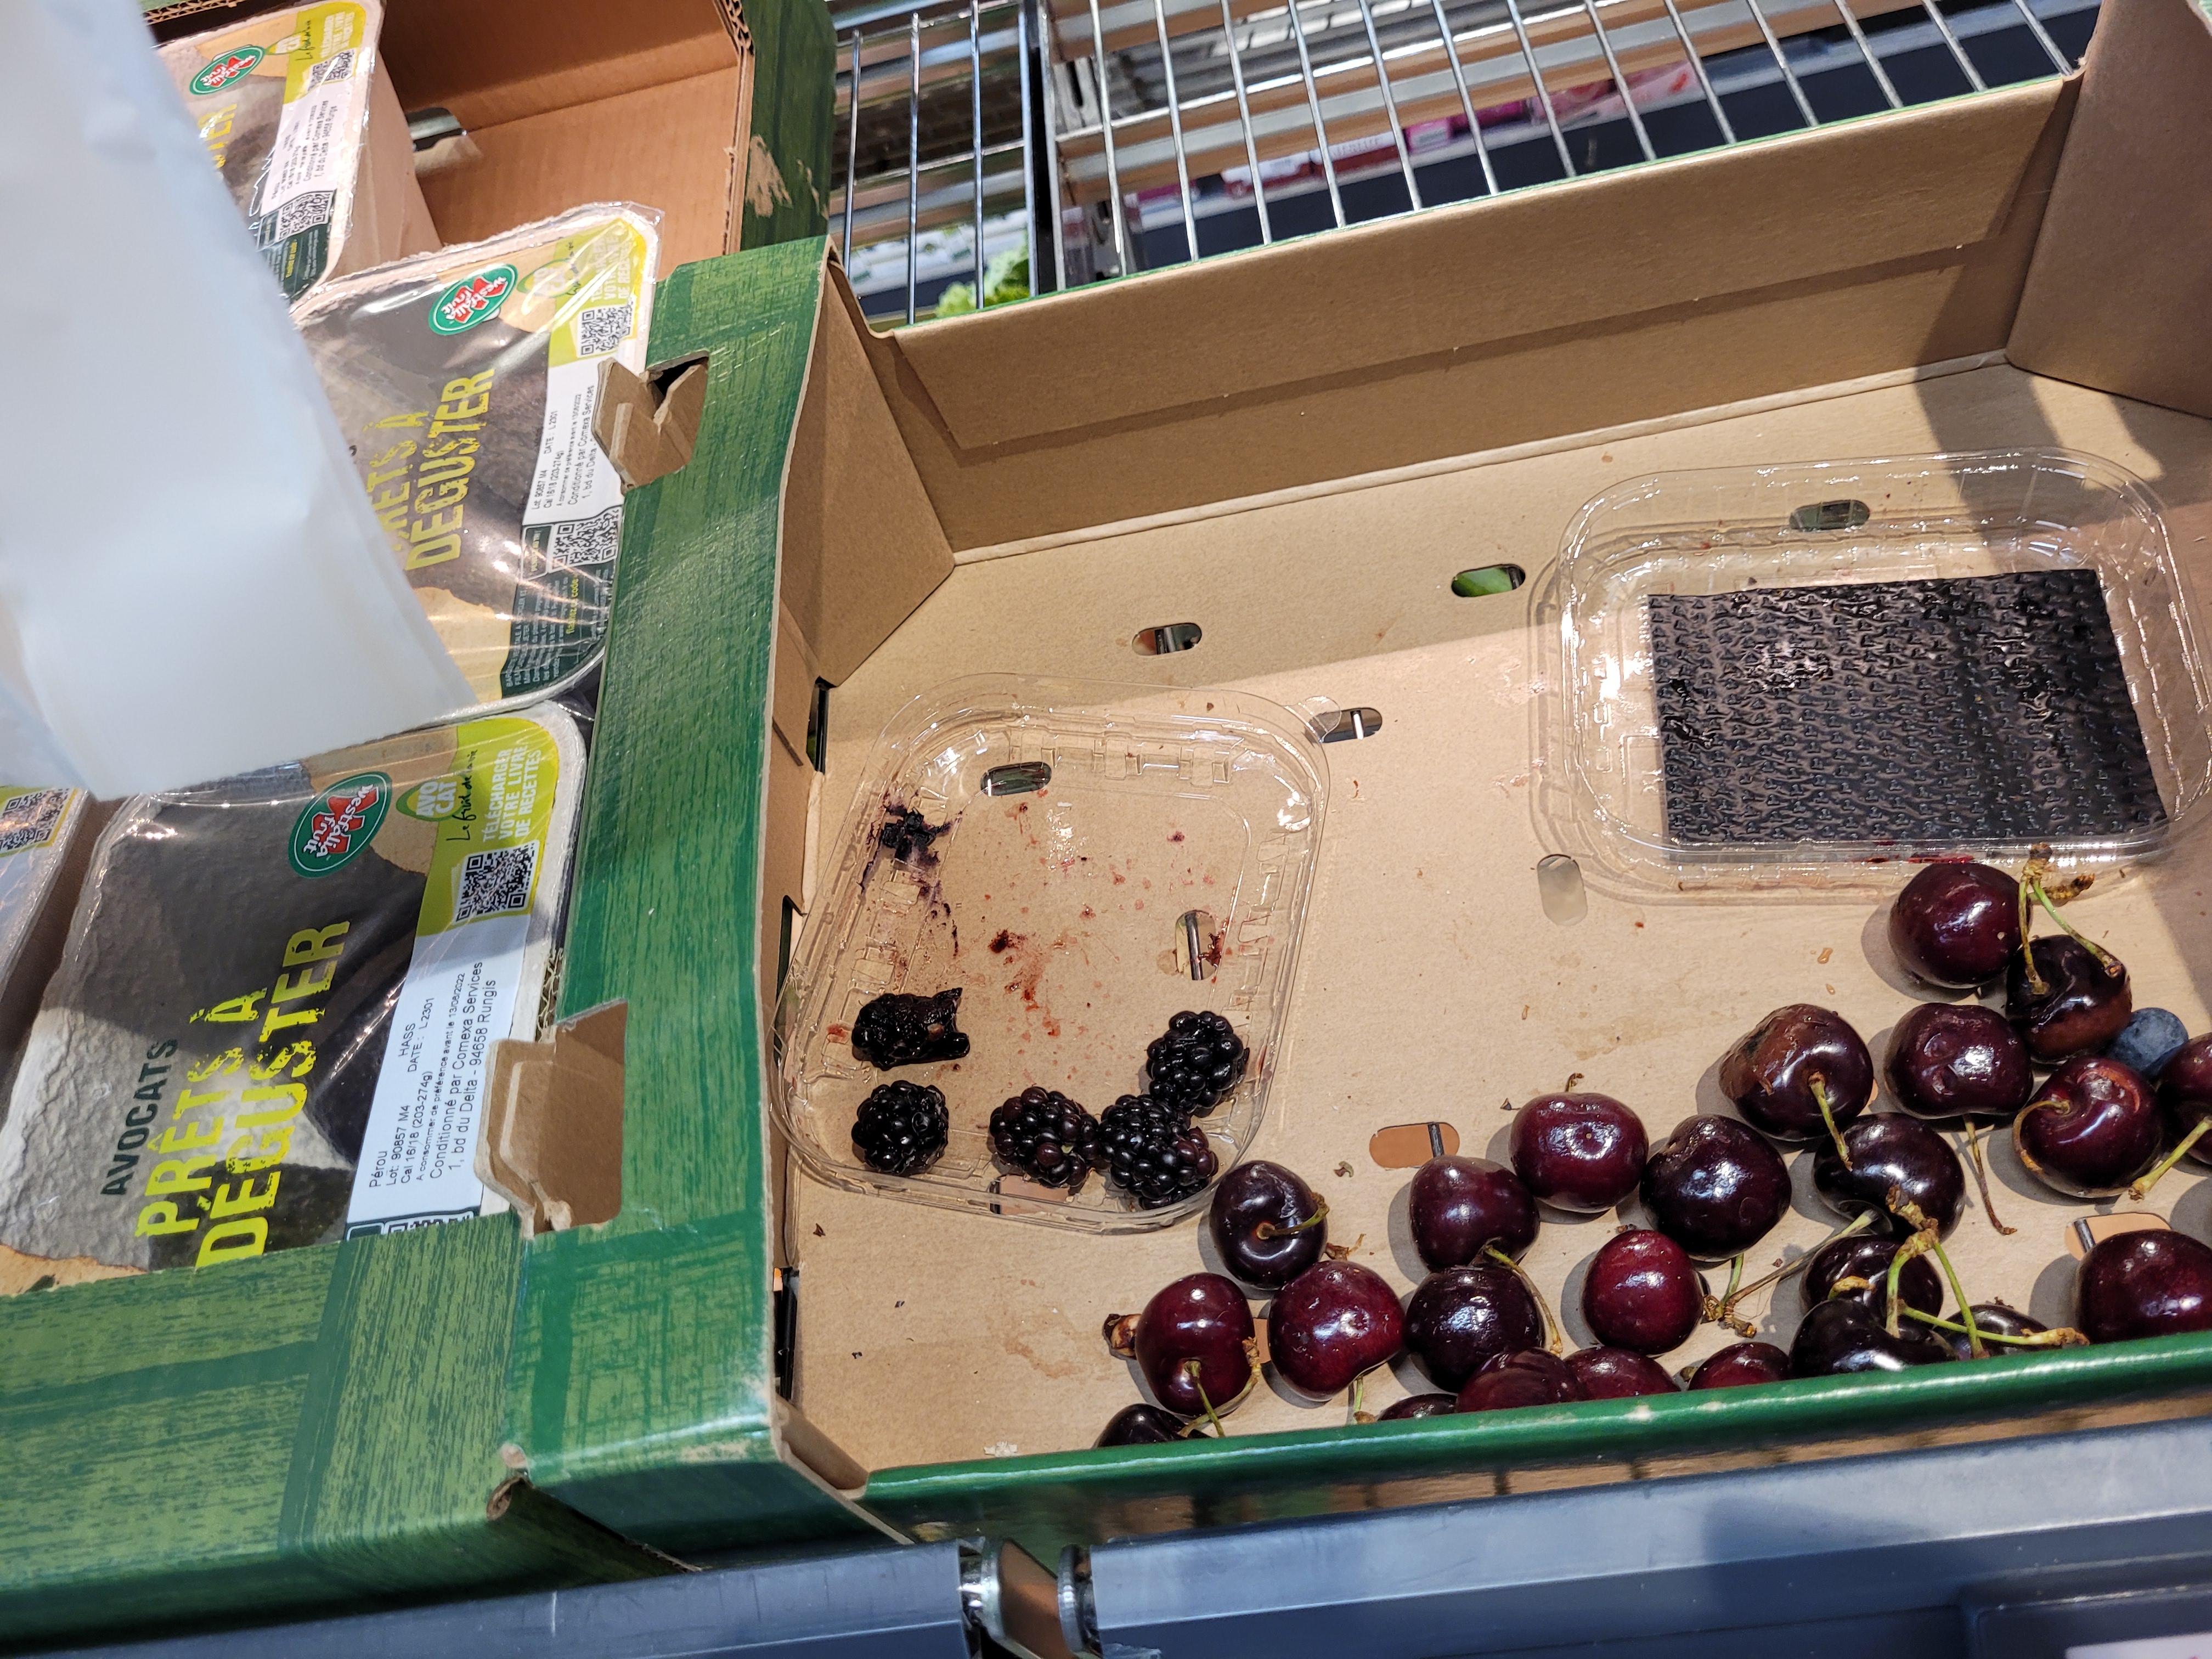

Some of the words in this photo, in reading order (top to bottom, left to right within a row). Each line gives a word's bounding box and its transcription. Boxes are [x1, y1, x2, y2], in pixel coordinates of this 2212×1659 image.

[441, 290, 473, 314] fruit
[445, 276, 507, 320] westfalia
[578, 447, 586, 460] par
[582, 385, 595, 416] Services
[585, 468, 594, 479] du
[586, 447, 597, 467] Delta
[570, 578, 579, 597] code
[461, 775, 472, 790] de
[507, 745, 528, 786] LIVRE
[517, 749, 542, 816] RECETTES
[416, 781, 439, 817] AVO
[435, 781, 457, 814] CAT
[452, 793, 477, 821] fruit
[481, 749, 513, 843] TÉLÉCHARGER
[316, 784, 374, 858] westfalia
[446, 824, 471, 841] Le
[499, 791, 520, 840] VOTRE
[514, 818, 531, 838] DE
[303, 816, 336, 854] fruit
[462, 962, 483, 1015] Services
[477, 979, 497, 1023] Rungis
[398, 1023, 416, 1057] HASS
[443, 1031, 453, 1054] avant
[446, 1021, 455, 1029] le
[408, 1042, 423, 1073] DATE
[452, 1018, 473, 1070] Comexa
[469, 1028, 488, 1066] 94658
[195, 921, 351, 1267] DÉGUSTER
[432, 1055, 448, 1104] préférence
[449, 1075, 463, 1096] par
[460, 1079, 478, 1111] Delta
[100, 1039, 178, 1195] AVOCATS
[134, 1047, 245, 1237] PRÊTS
[190, 987, 268, 1024] À
[398, 1104, 410, 1124] M4
[400, 1168, 412, 1184] Cal
[413, 1070, 433, 1128] (203-274g)
[430, 1105, 438, 1115] de
[457, 1119, 469, 1133] du
[391, 1126, 407, 1160] 90857
[419, 1115, 436, 1172] consommer
[430, 1099, 457, 1180] Conditionné
[454, 1138, 466, 1154] bd
[369, 1150, 388, 1188] Pérou
[386, 1165, 399, 1186] Lot:
